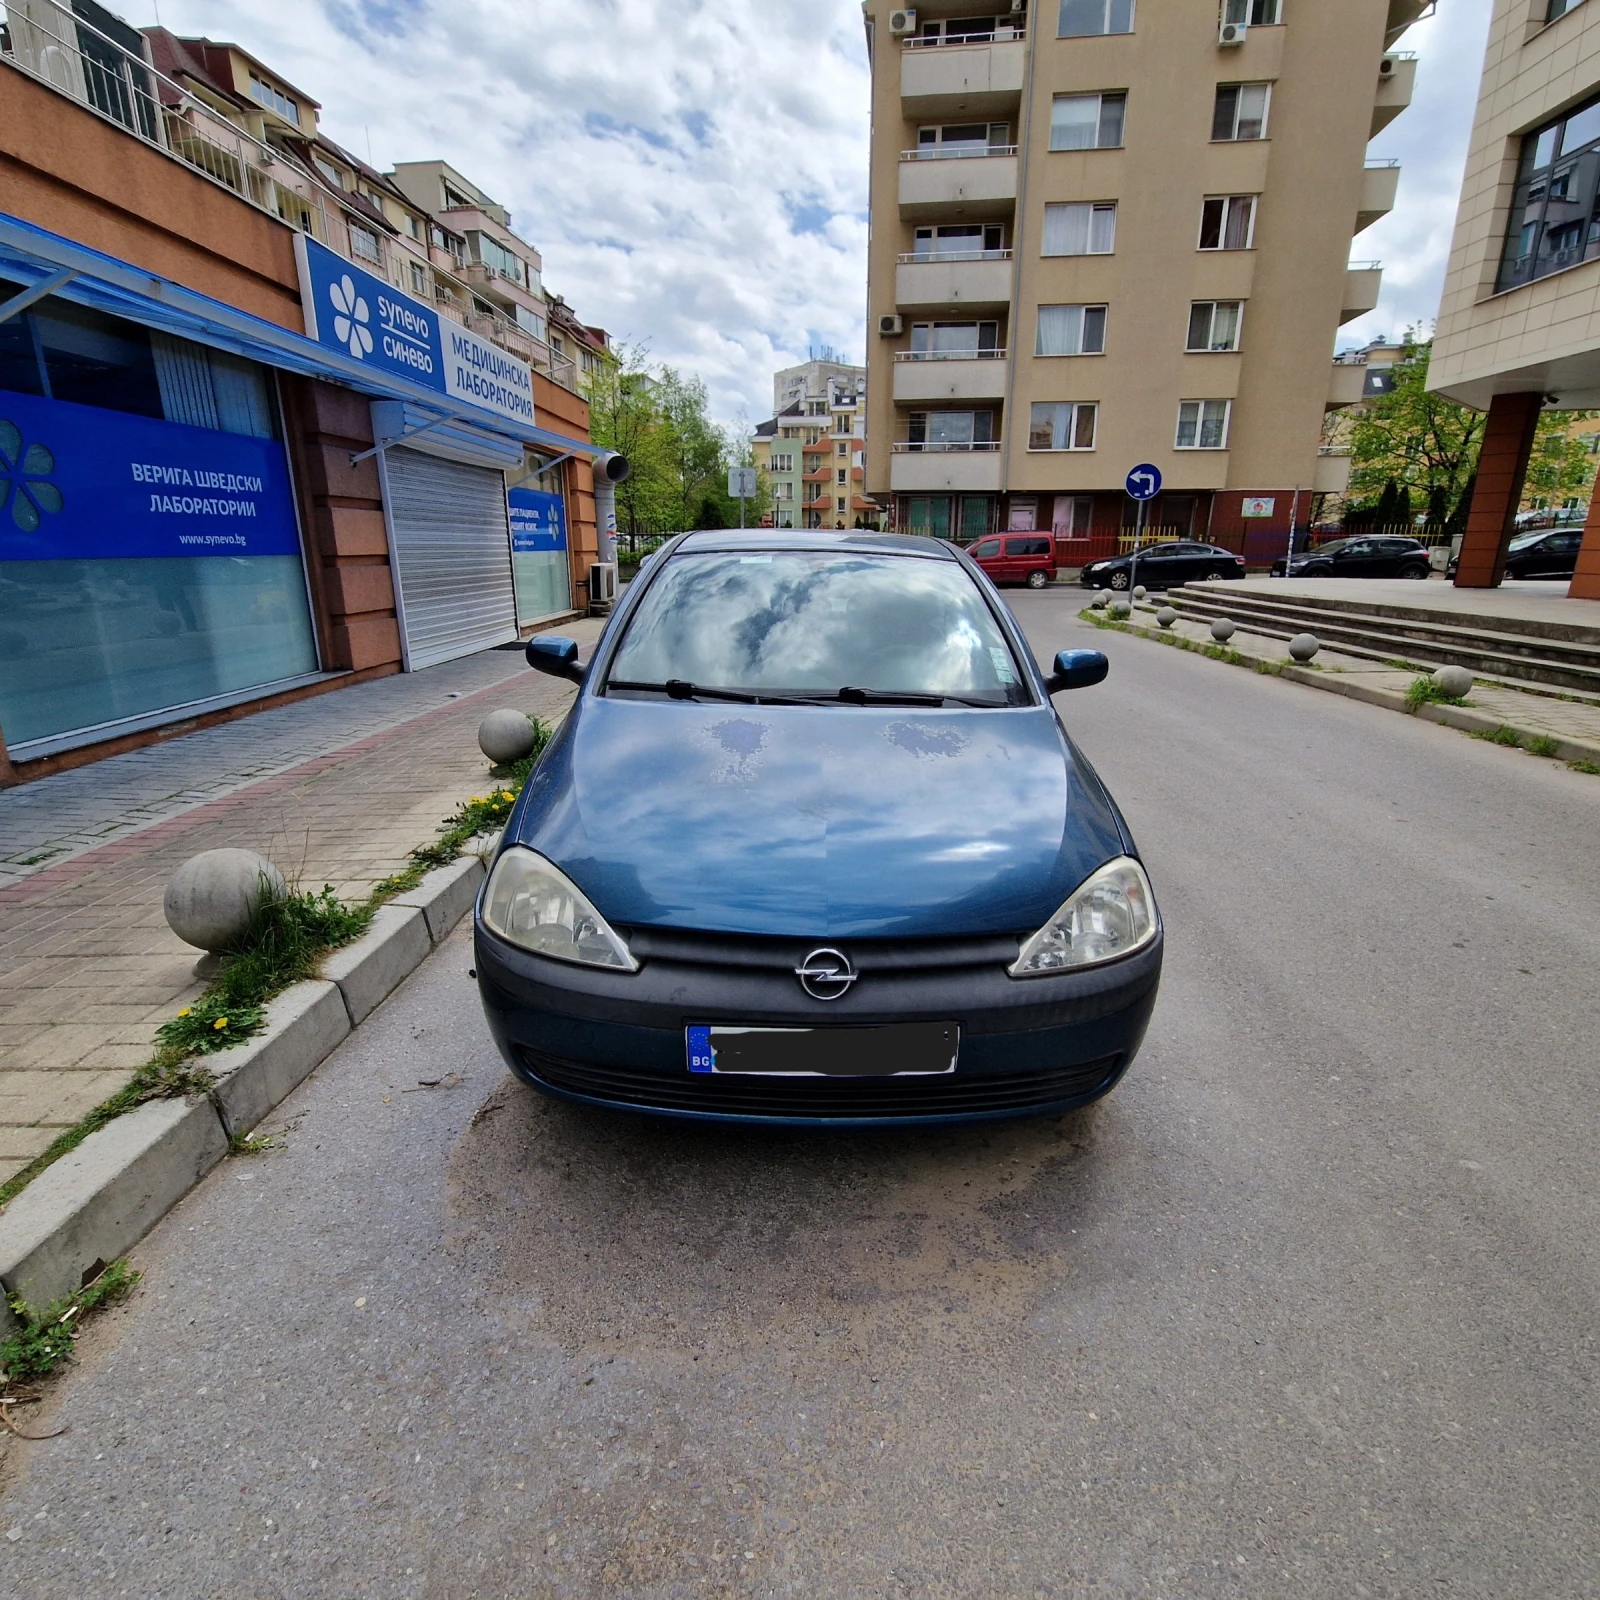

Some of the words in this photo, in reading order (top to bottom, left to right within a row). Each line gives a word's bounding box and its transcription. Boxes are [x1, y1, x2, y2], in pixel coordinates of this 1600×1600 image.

[377, 295, 429, 338] synevo
[451, 332, 530, 392] МЕДИЦИНСКА
[456, 366, 533, 419] ЛАБОРАТОРИЯ
[131, 462, 193, 487] ВЕРИГА
[193, 470, 263, 493] ШВЕДСКИ
[150, 494, 257, 517] ЛАБОРАТОРИИ
[179, 533, 247, 547] www.synevo.bg
[692, 1056, 710, 1067] BG
